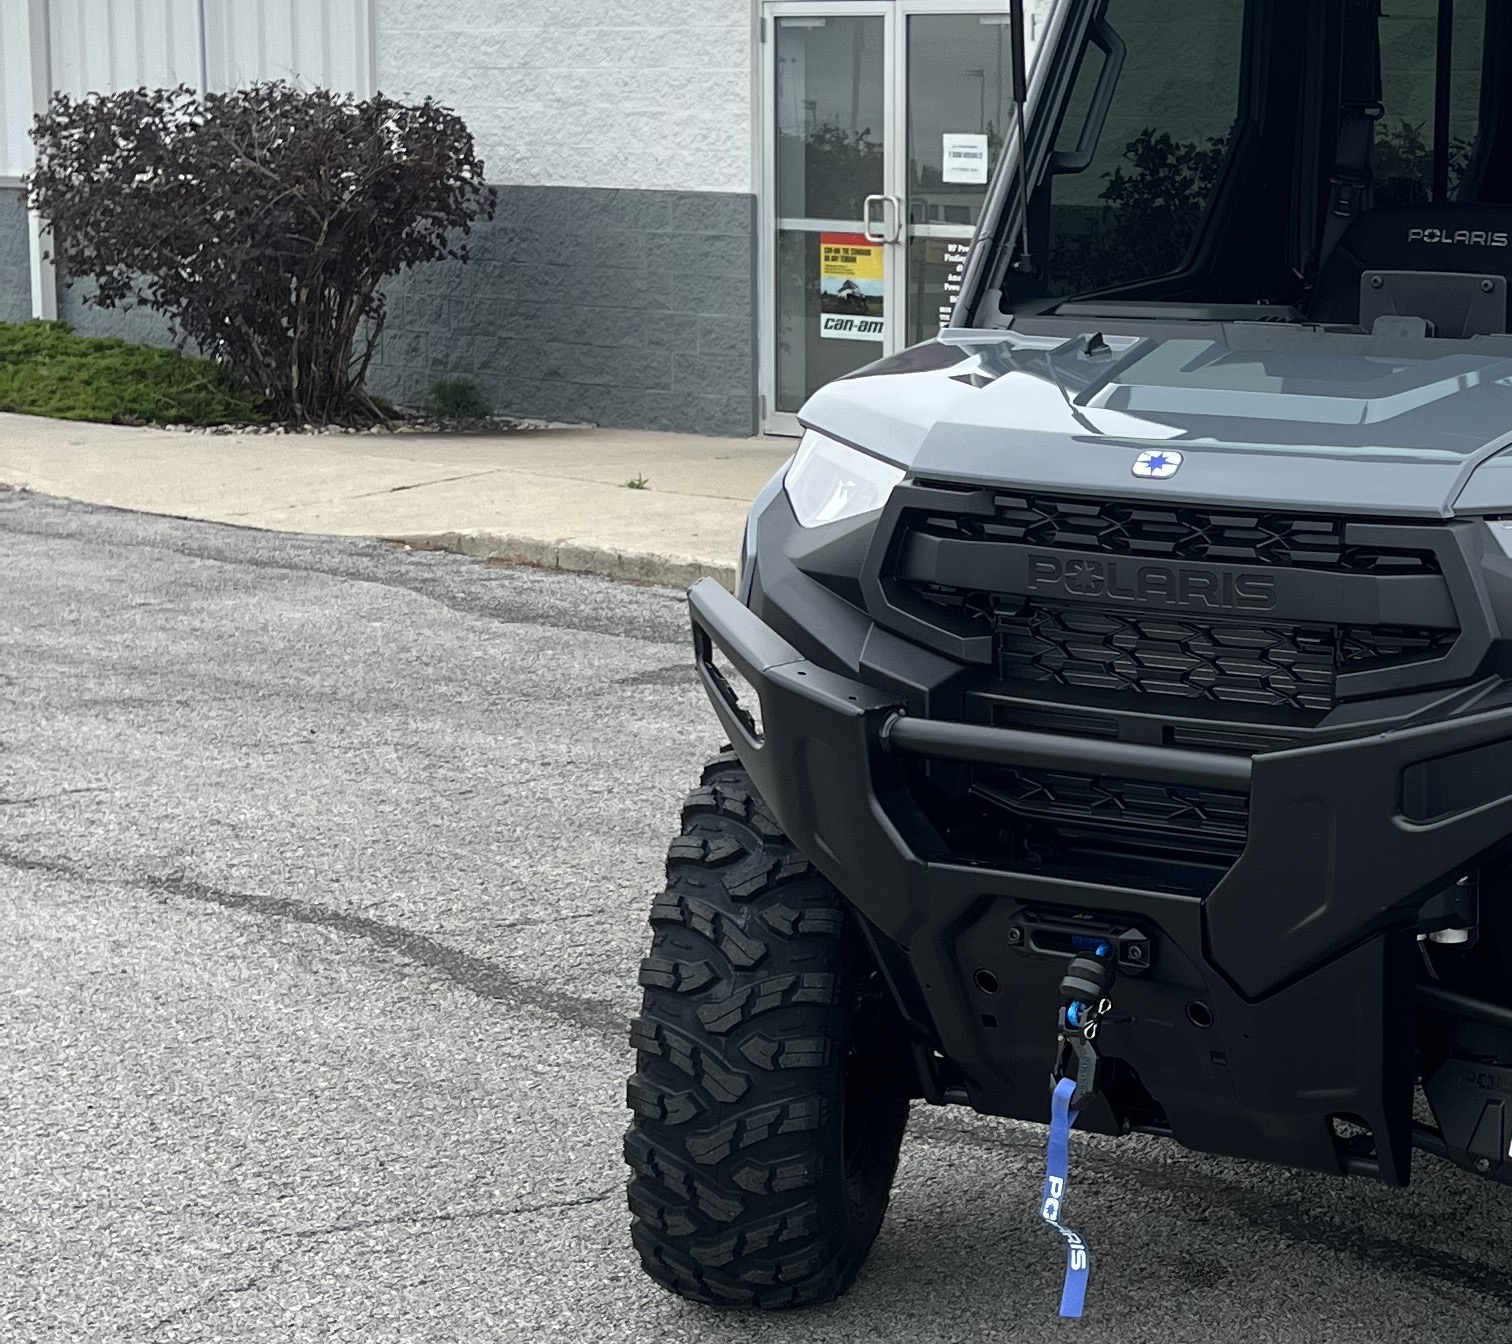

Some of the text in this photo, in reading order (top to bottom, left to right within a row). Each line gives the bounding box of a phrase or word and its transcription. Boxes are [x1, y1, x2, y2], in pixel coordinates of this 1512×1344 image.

[1407, 228, 1509, 247] POLARIS
[824, 317, 884, 334] can-am
[1027, 553, 1278, 611] POLARIS
